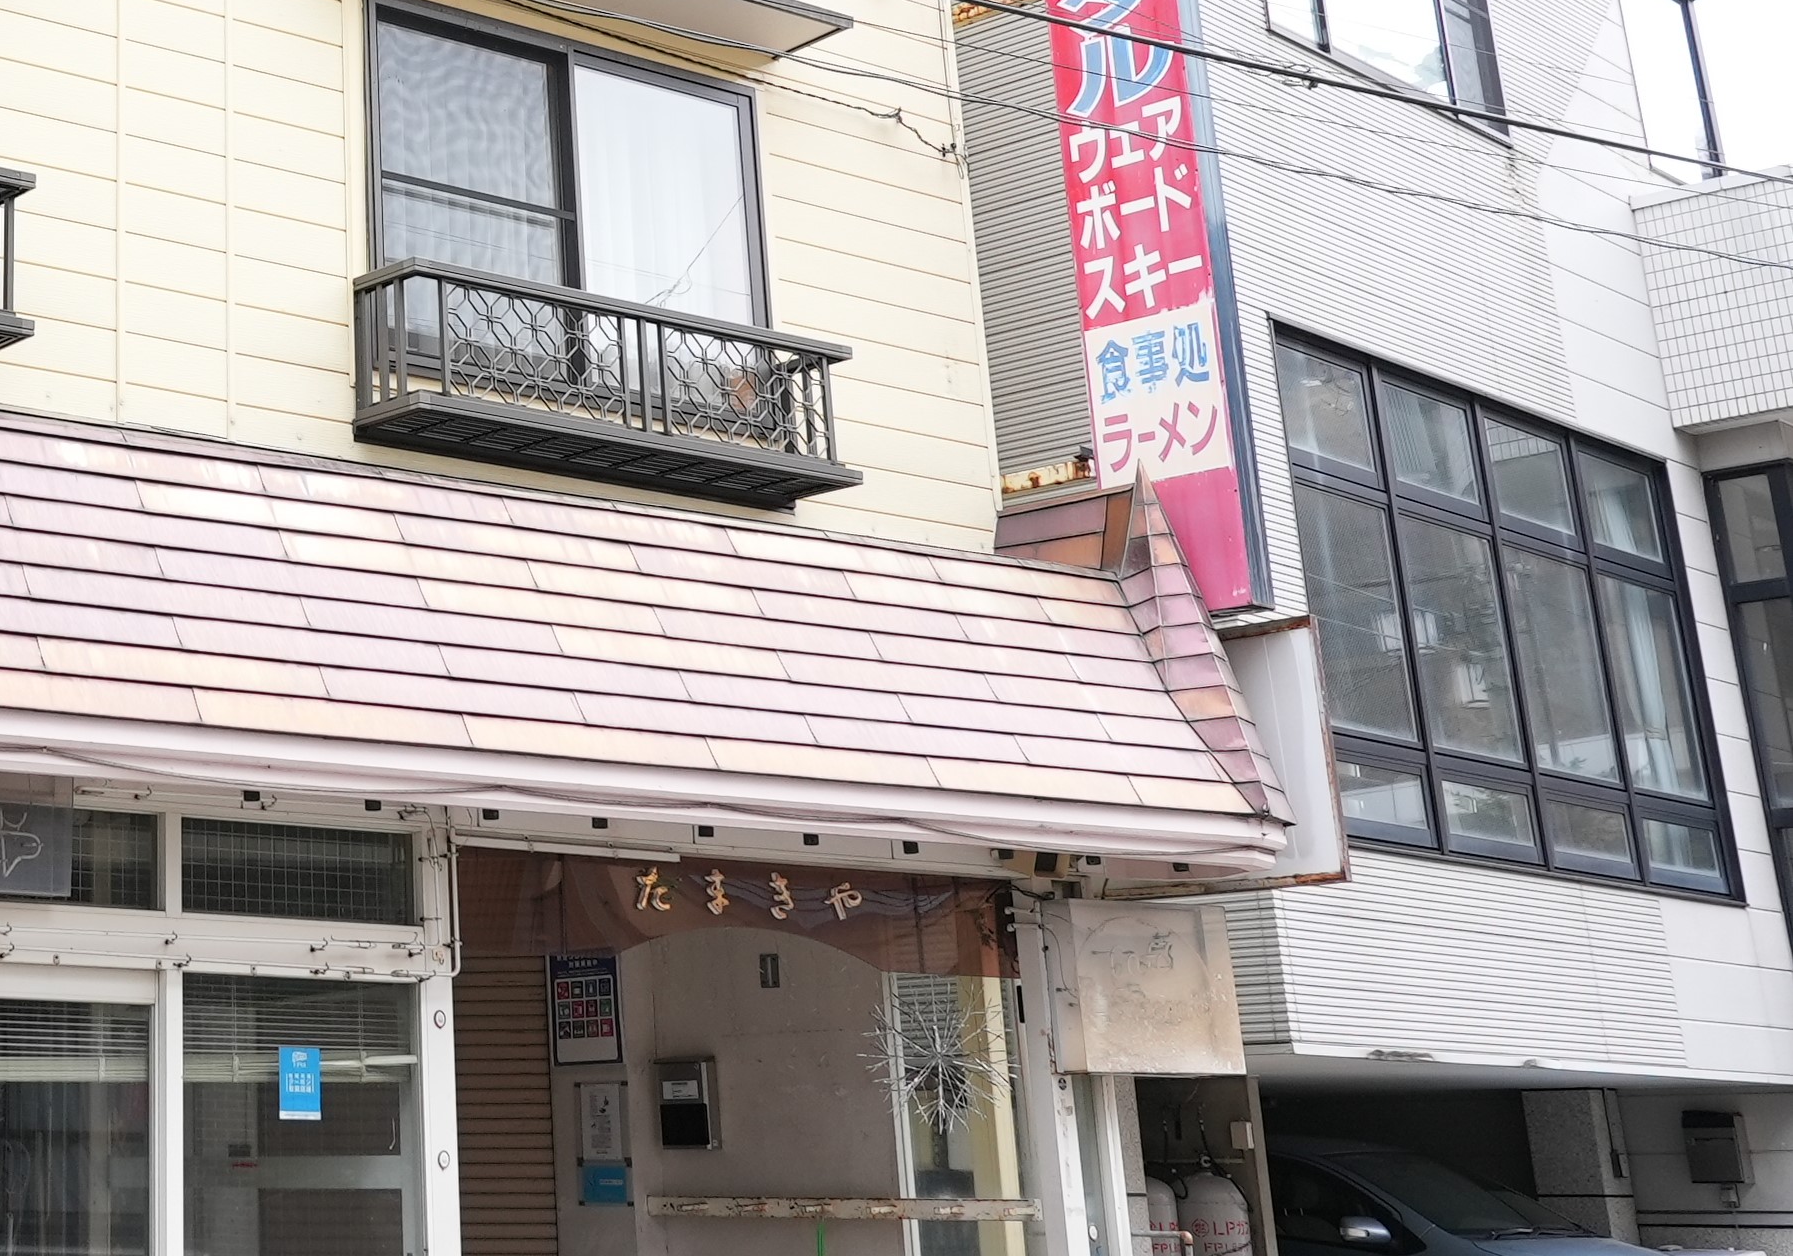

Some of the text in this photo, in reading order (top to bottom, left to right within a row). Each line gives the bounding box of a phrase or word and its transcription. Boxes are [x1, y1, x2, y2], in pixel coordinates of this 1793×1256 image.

[1076, 163, 1193, 250] ボード
[1083, 243, 1203, 320] スキー
[1095, 321, 1210, 404] 食事処
[1102, 400, 1218, 473] ラーメン
[636, 866, 863, 921] たまきや
